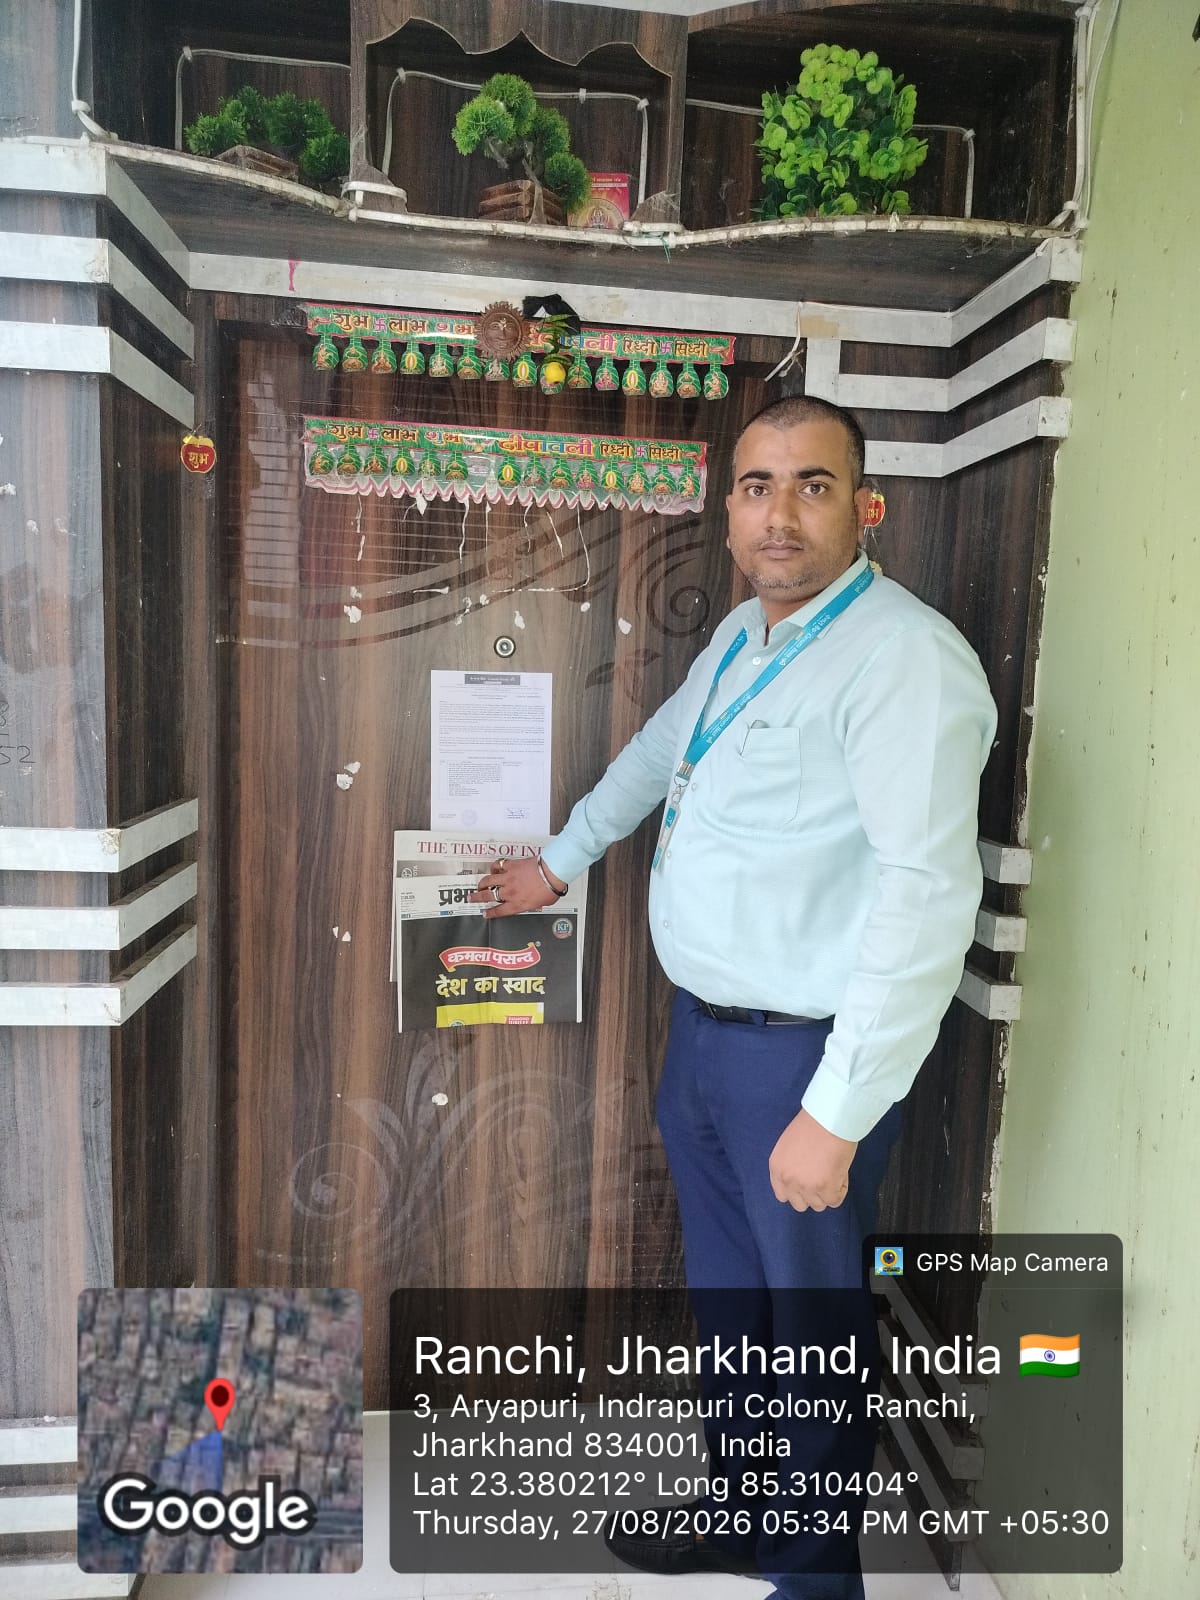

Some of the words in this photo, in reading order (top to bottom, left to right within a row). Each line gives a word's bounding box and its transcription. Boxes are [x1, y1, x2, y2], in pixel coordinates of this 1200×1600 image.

[332, 312, 370, 331] शुभ
[388, 317, 428, 334] लाभ
[328, 423, 364, 439] शुभ
[381, 427, 419, 442] लाभ
[424, 430, 462, 445] शुभ
[498, 433, 595, 456] दीपावली
[187, 451, 210, 469] शुभ
[416, 841, 447, 854] THE
[451, 842, 497, 856] TIMES
[499, 843, 519, 856] OF
[447, 950, 491, 963] कमला
[492, 950, 535, 965] पसन्द
[435, 973, 468, 998] देश
[474, 976, 500, 994] का
[502, 976, 547, 994] स्वाद
